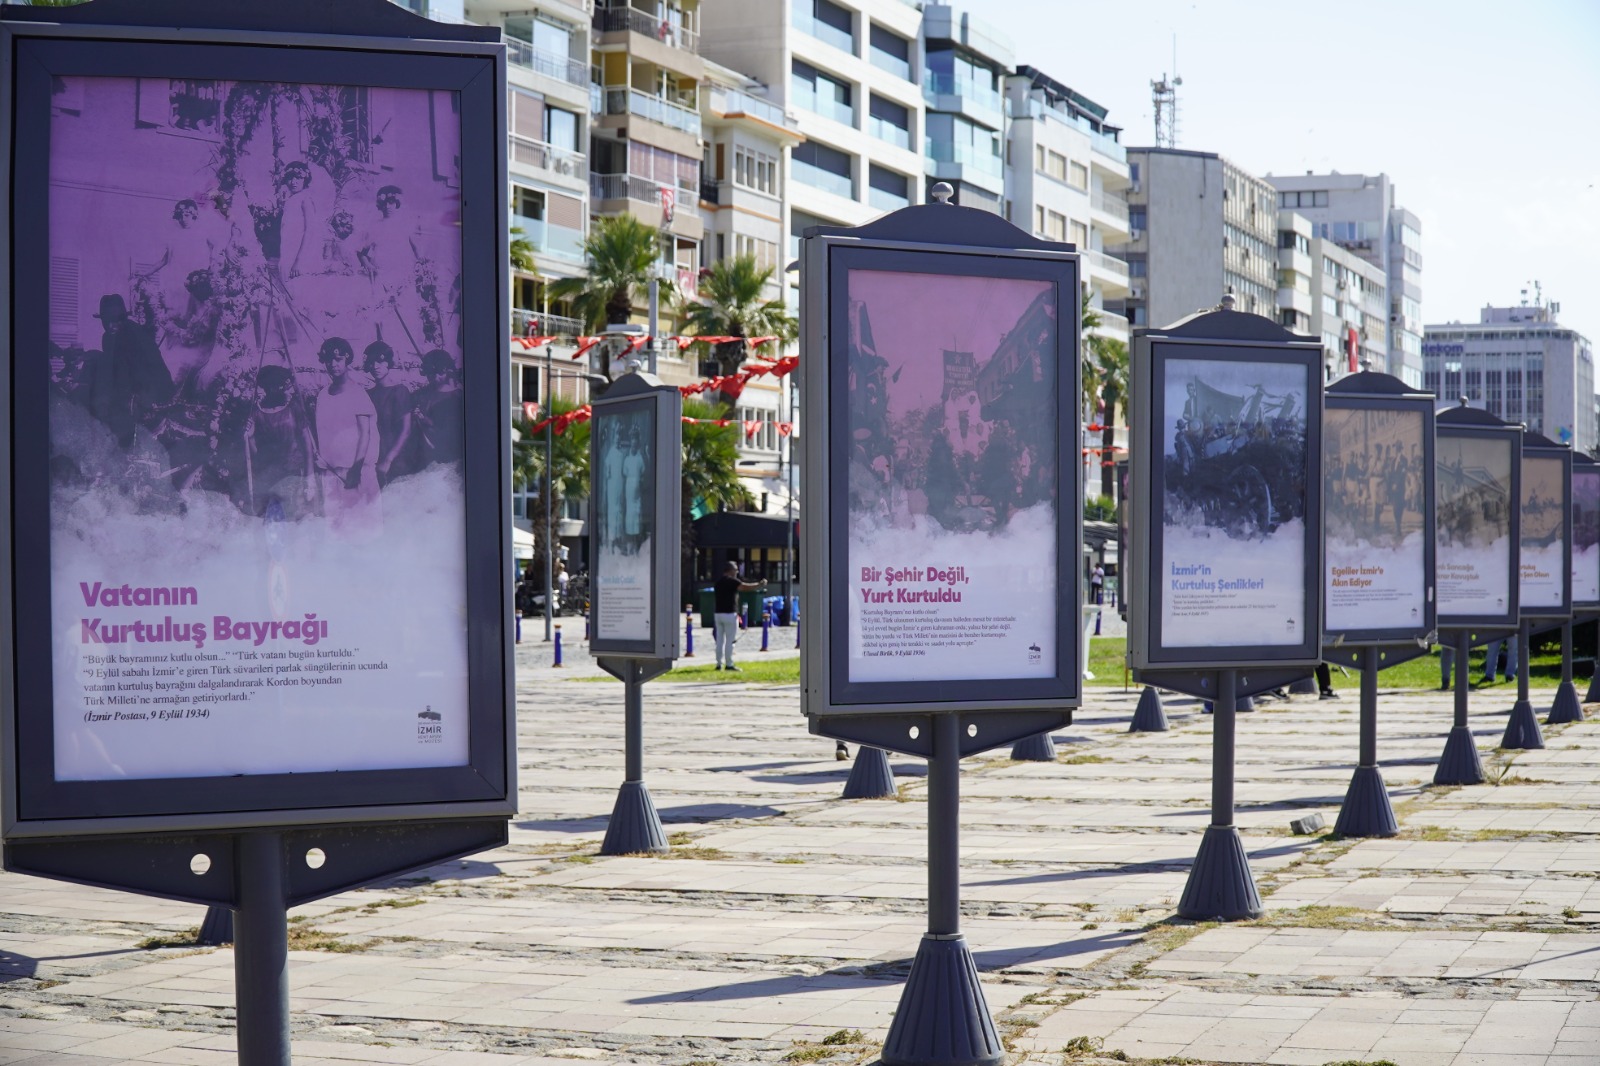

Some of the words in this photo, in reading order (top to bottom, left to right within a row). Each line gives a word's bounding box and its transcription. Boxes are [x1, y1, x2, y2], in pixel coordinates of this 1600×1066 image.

[1332, 566, 1358, 577] Egeliler
[1447, 563, 1474, 572] Sancağa
[862, 567, 882, 581] Bir
[885, 567, 924, 586] Şehir
[927, 566, 969, 585] Değil,
[1332, 578, 1348, 587] Akın
[1349, 578, 1372, 588] Ediyor
[1172, 580, 1216, 592] Kurtuluş
[1218, 578, 1264, 592] Şenlikleri
[80, 582, 197, 607] Vatanın
[861, 589, 893, 603] Yurt
[897, 588, 961, 602] Kurtuldu
[81, 615, 206, 649] Kurtuluş
[214, 614, 328, 646] Bayrağı
[120, 653, 168, 666] bayramınız
[171, 653, 192, 662] kutlu
[289, 650, 314, 660] bugün
[96, 668, 119, 679] Eylül
[122, 667, 149, 676] sabahı
[187, 667, 208, 677] giren
[210, 666, 231, 675] Türk
[234, 664, 273, 674] süvarileri
[276, 663, 301, 674] parlak
[304, 662, 355, 672] süngülerinin
[358, 661, 388, 670] ucunda
[84, 682, 115, 691] vatanın
[118, 682, 153, 692] kurtuluş
[156, 680, 195, 692] bayrağını
[198, 679, 264, 690] dalgalandırarak
[267, 677, 298, 686] Kordon
[301, 676, 342, 688] boyundan
[84, 696, 104, 706] Türk
[153, 694, 190, 705] armağan
[84, 712, 112, 722] (İzmir
[114, 711, 149, 721] Postası,
[151, 710, 156, 719] 9
[159, 709, 184, 720] Eylül
[186, 709, 210, 719] 1934)
[418, 725, 441, 734] İZMİR
